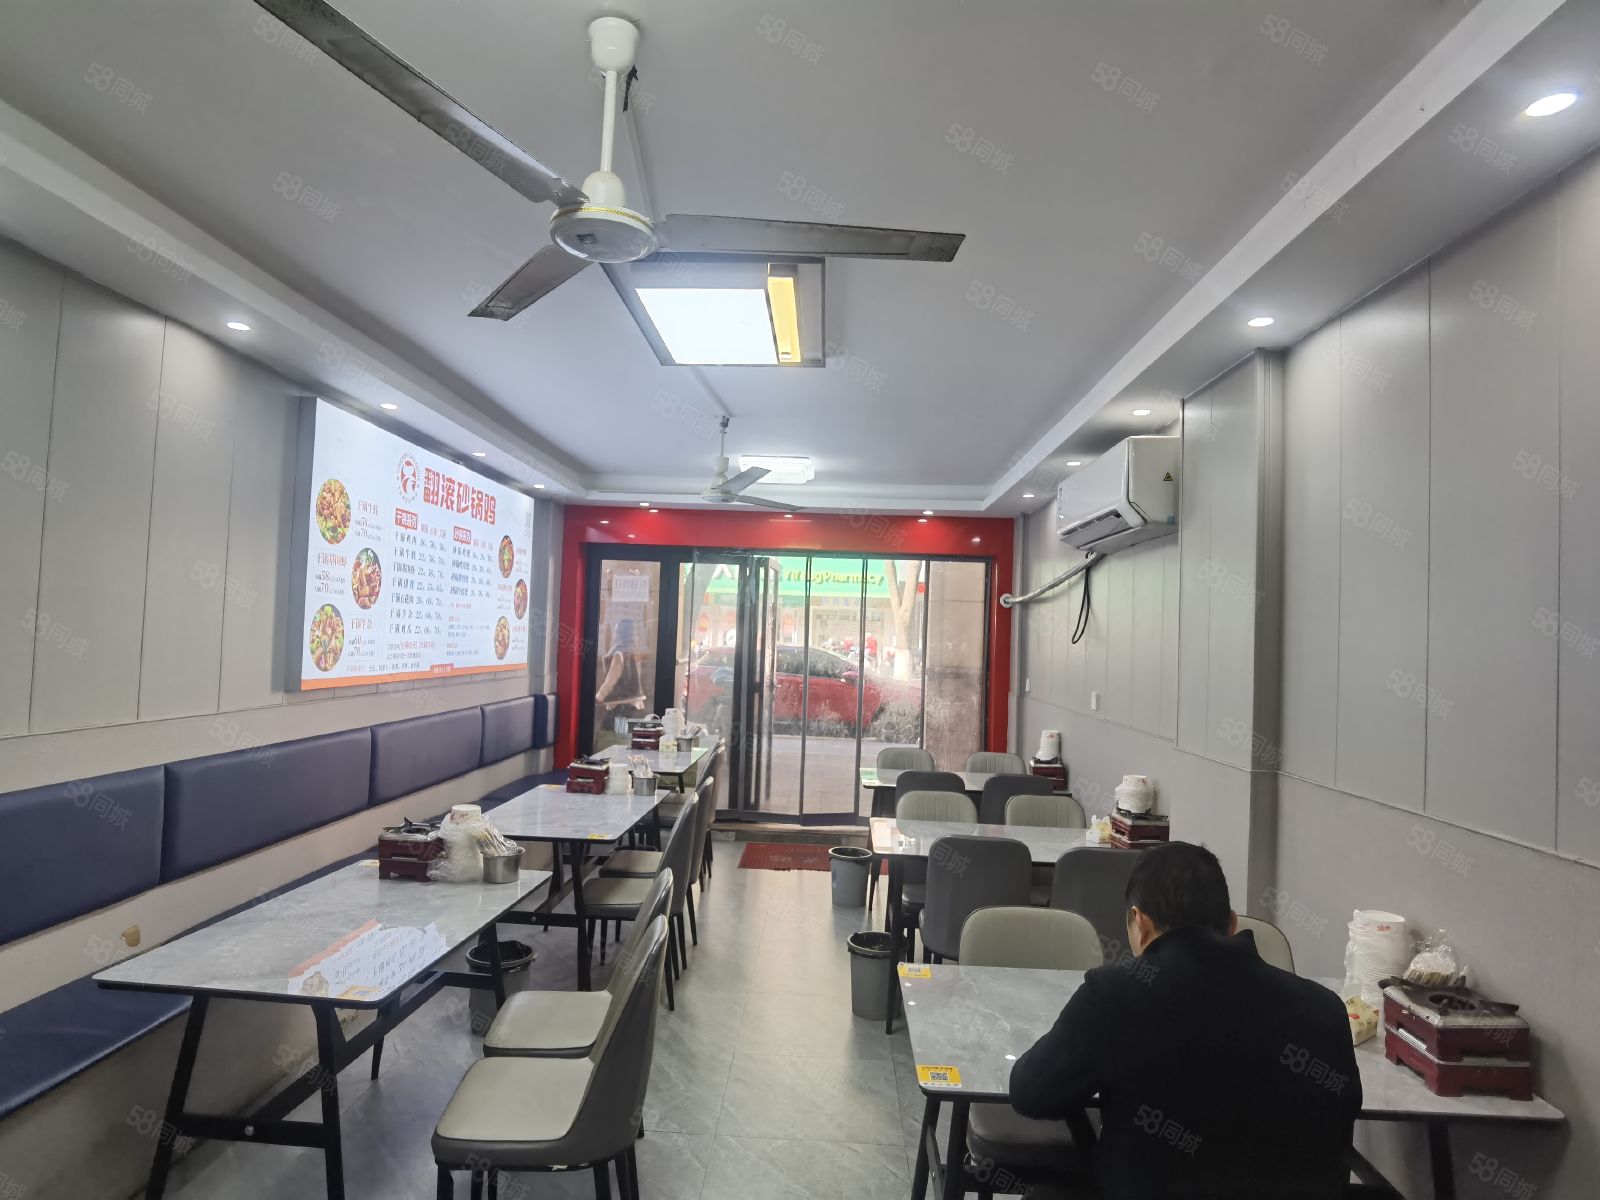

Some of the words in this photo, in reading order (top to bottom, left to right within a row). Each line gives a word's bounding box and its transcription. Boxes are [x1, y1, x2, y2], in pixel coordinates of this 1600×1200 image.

[423, 466, 497, 526] 翻滚砂锅鸡
